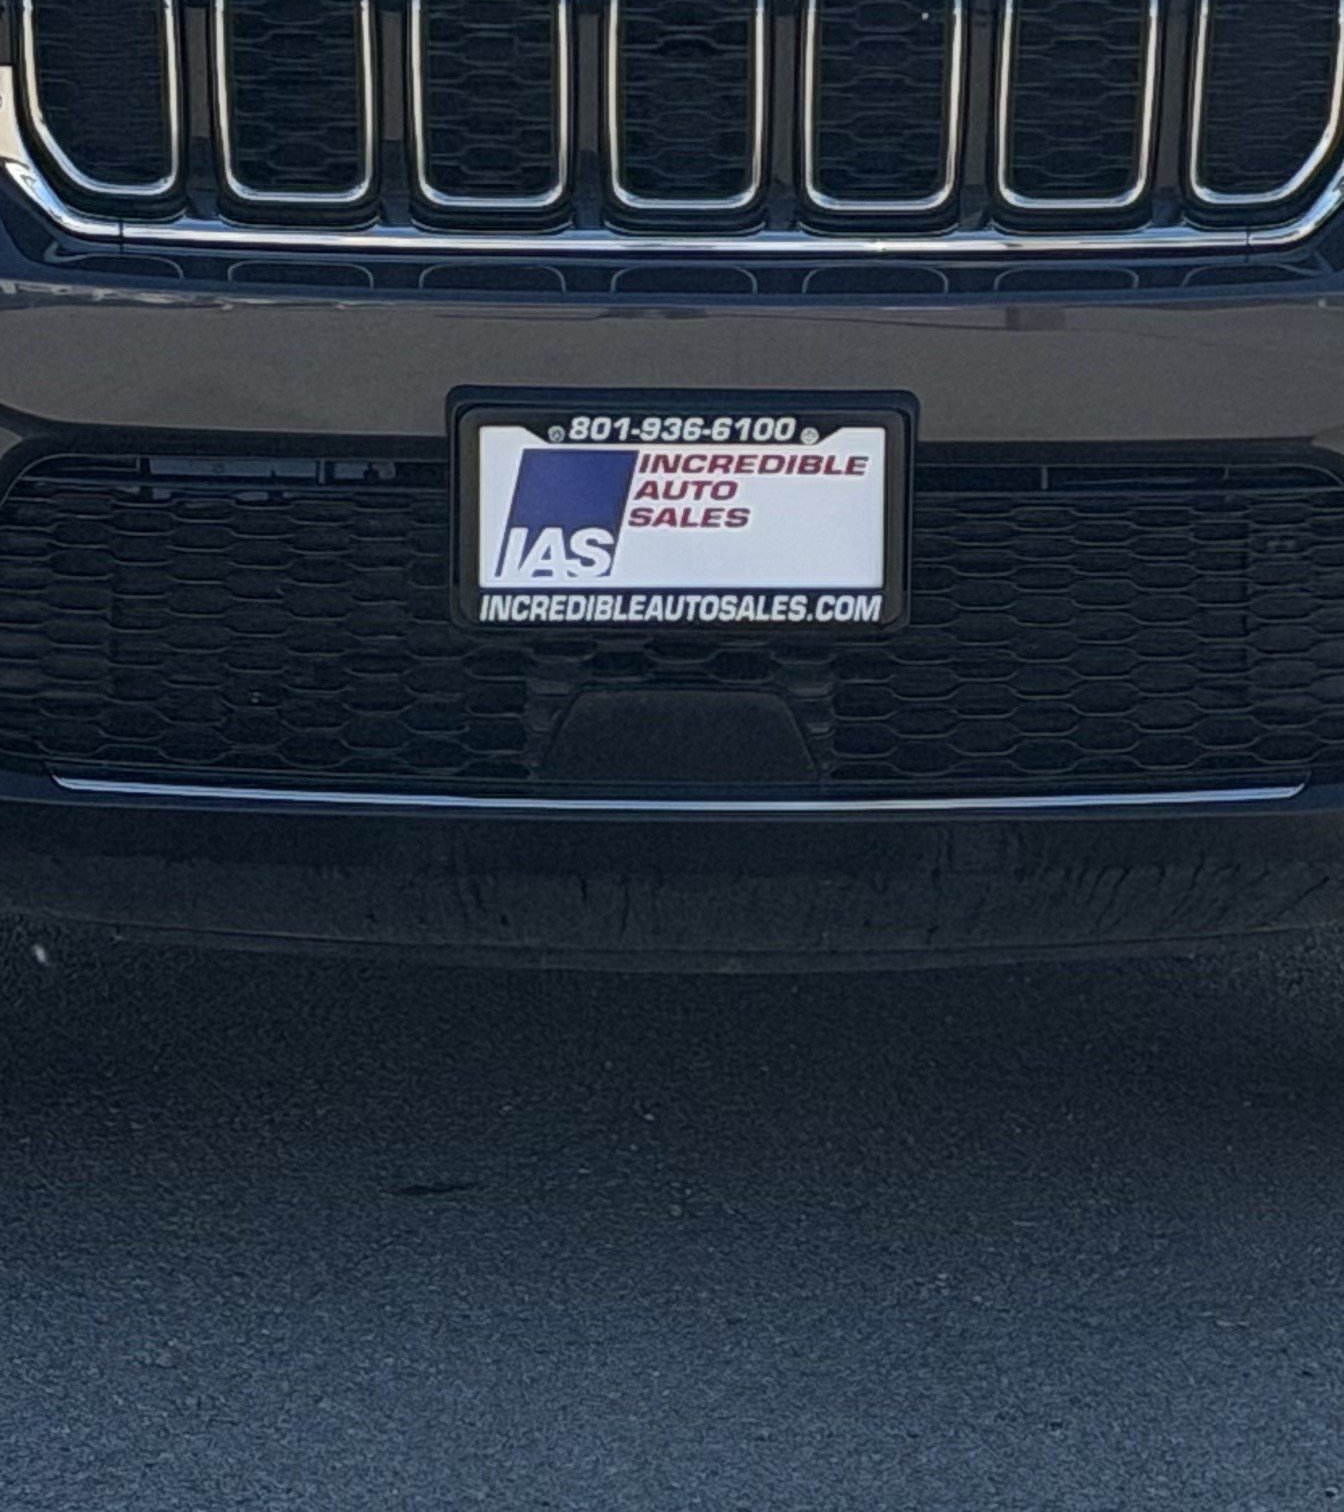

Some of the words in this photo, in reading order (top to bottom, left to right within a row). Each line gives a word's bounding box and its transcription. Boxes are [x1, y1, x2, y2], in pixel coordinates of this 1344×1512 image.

[568, 416, 797, 442] 801-936-6100
[638, 453, 870, 476] INCREDIBLE
[633, 479, 739, 501] AUTO
[627, 506, 752, 528] SALES
[499, 527, 616, 579] IAS
[479, 594, 883, 623] INCREDIBLEAUTOSALES.COM
